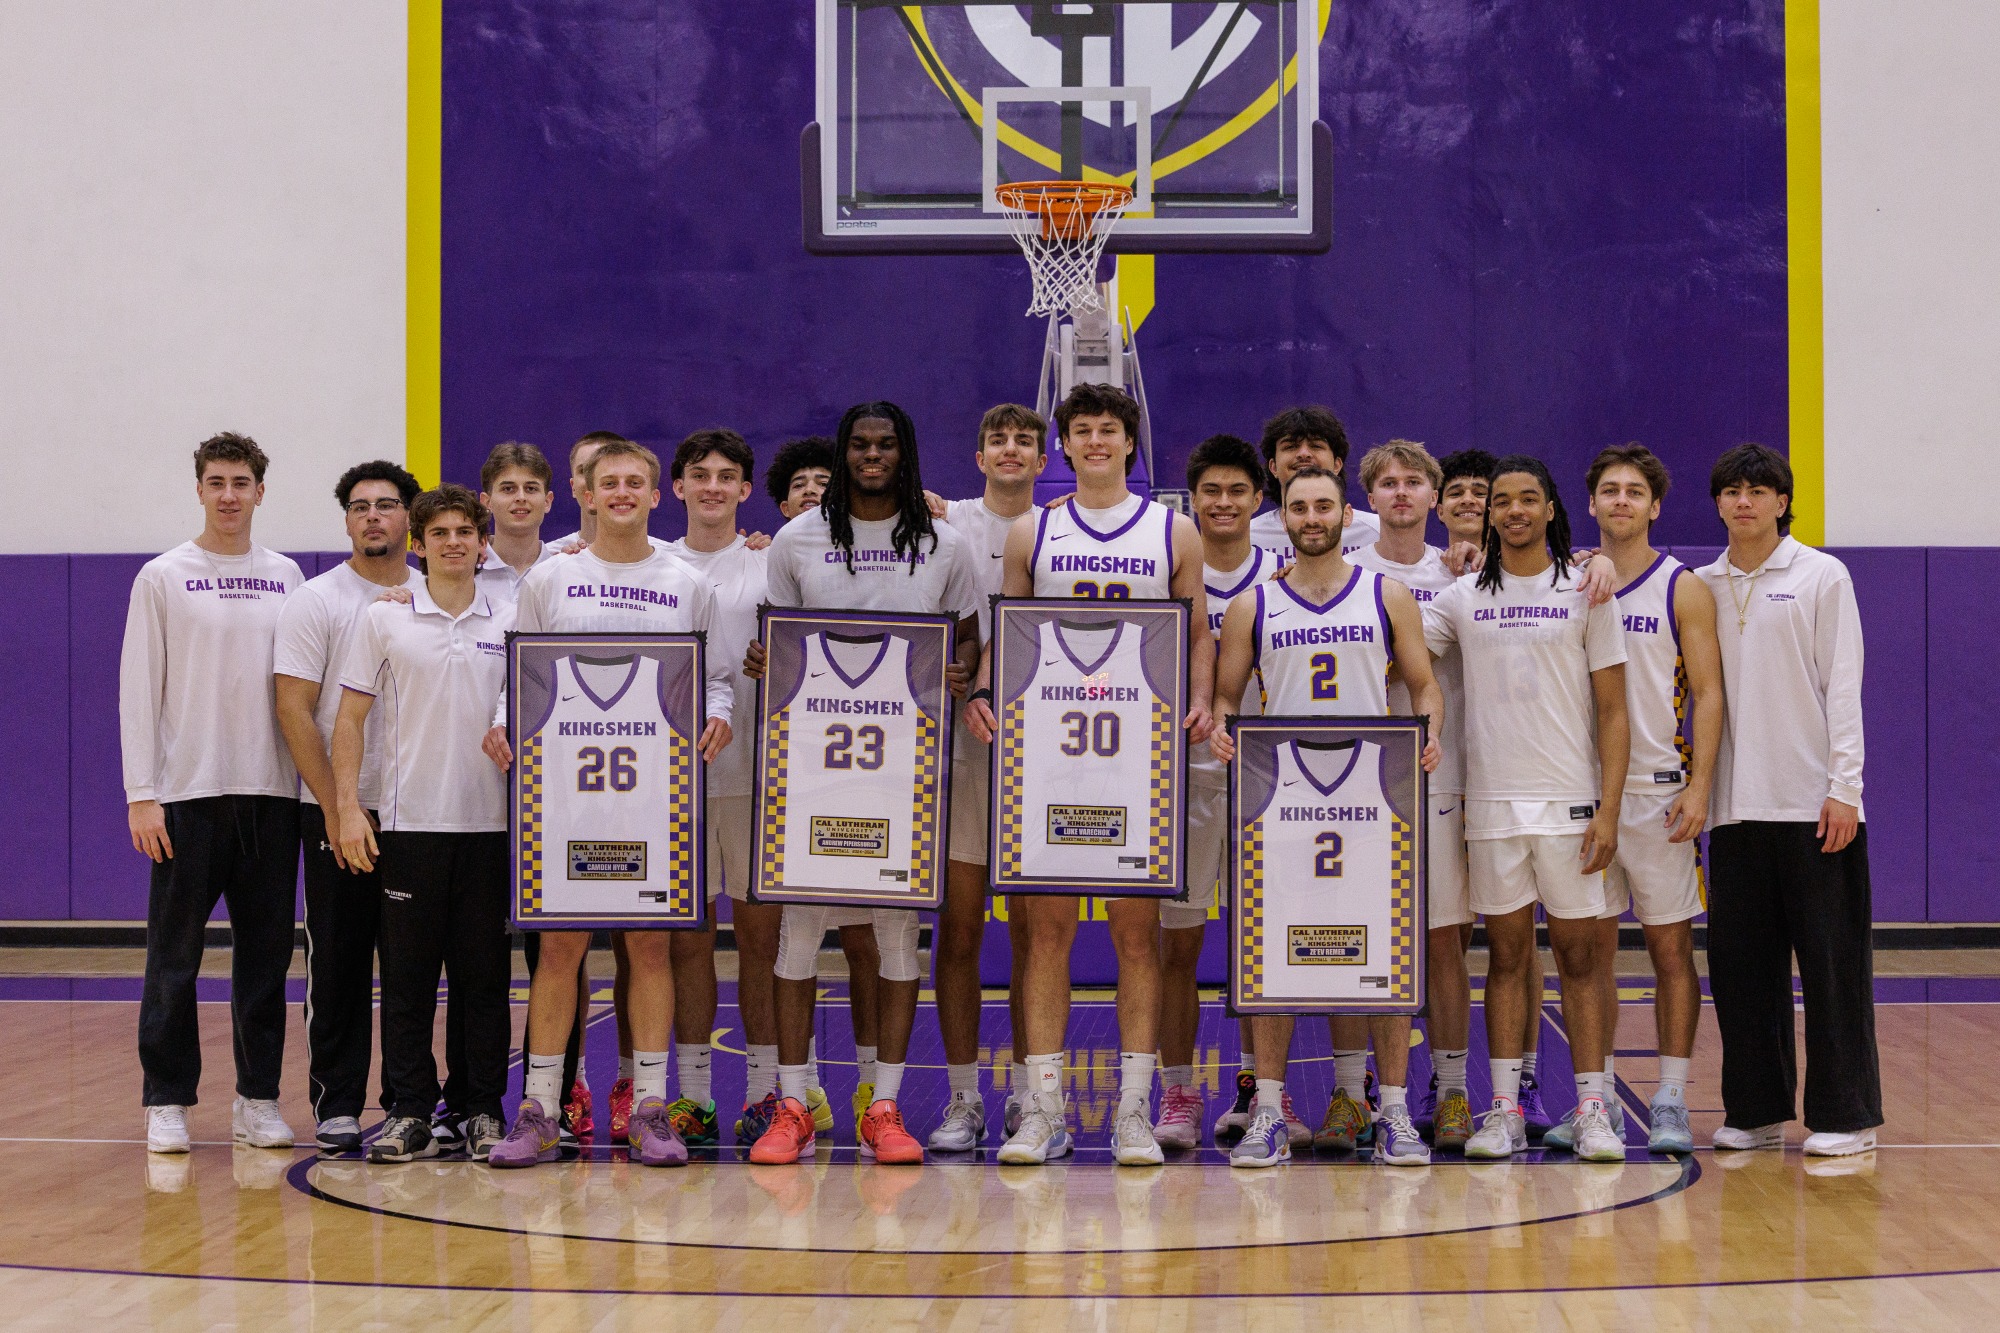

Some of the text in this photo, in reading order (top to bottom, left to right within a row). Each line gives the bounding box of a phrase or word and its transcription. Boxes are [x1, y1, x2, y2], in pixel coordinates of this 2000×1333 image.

[1051, 555, 1155, 577] KINGSMEN
[186, 578, 285, 594] CAL LUTHERAN
[567, 585, 678, 608] CAL LUTHERAN
[600, 601, 647, 611] BASKETBALL
[1474, 606, 1569, 621] CAL LUTHERAN
[1271, 625, 1373, 650] KINGSMEN
[1310, 652, 1339, 701] 2
[1041, 686, 1139, 701] KINGSMEN
[806, 698, 904, 715] KINGSMEN
[558, 721, 657, 736] KINGSMEN
[1060, 710, 1121, 757] 30
[824, 723, 885, 772] 23
[577, 746, 637, 793] 26
[1280, 806, 1378, 821] KINGSMEN
[836, 820, 884, 829] LUTHERAN
[1314, 831, 1344, 878] 2
[587, 863, 628, 871] CAMDEN HYDE
[1325, 948, 1346, 956] REMER
